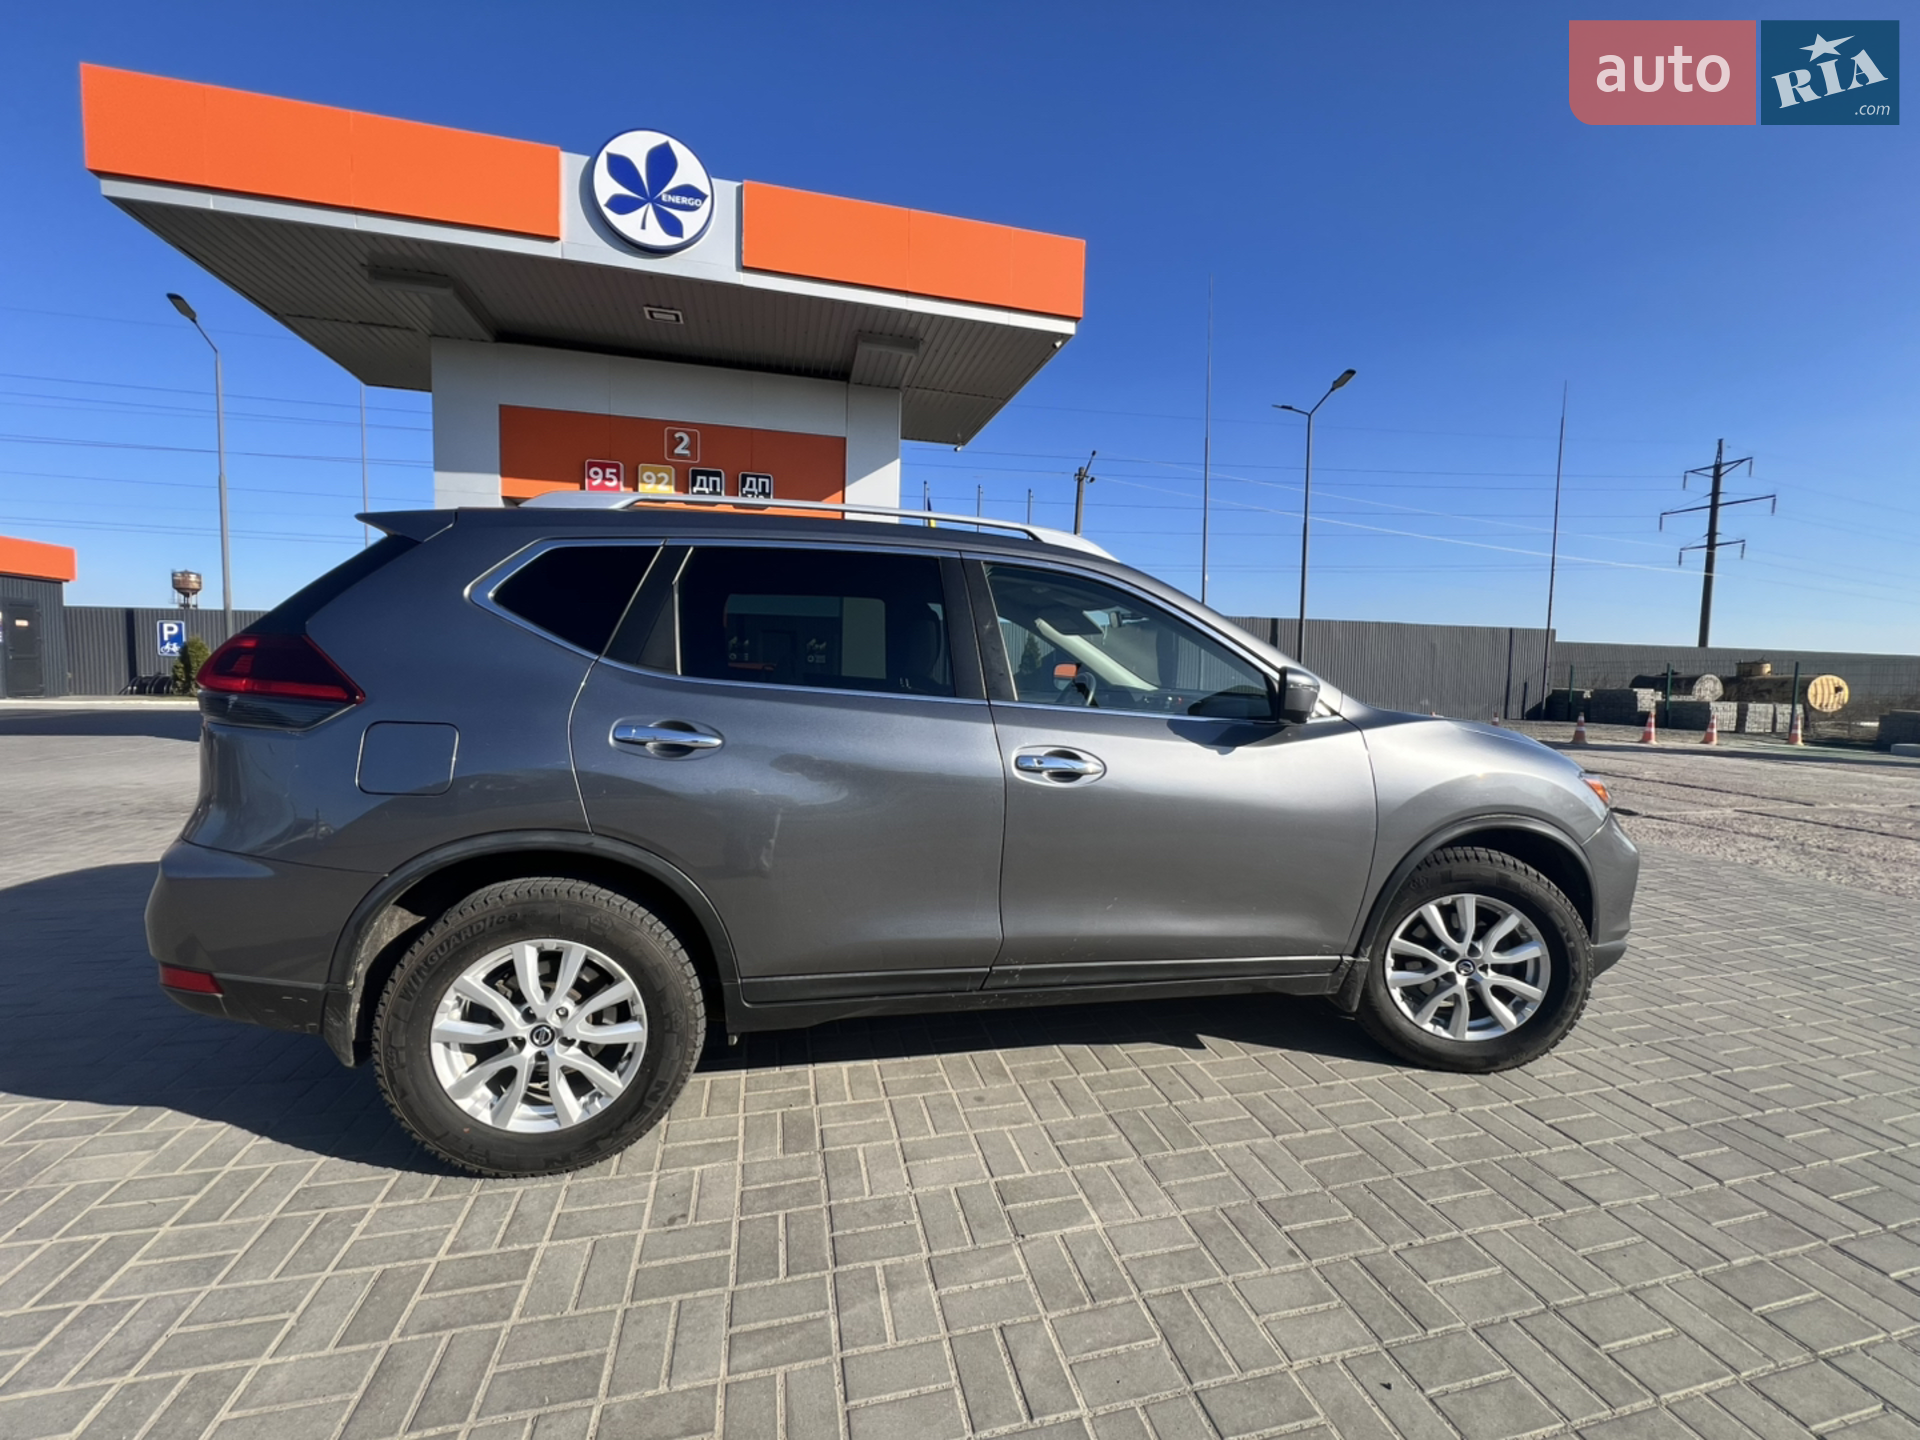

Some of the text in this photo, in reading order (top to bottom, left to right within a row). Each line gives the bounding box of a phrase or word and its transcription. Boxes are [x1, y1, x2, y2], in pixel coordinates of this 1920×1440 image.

[661, 193, 703, 207] ENERGO
[673, 431, 692, 458] 2
[588, 467, 618, 487] 95
[642, 471, 670, 492] 92
[692, 475, 721, 495] ДП
[742, 476, 770, 496] ДП
[162, 623, 179, 641] P
[399, 919, 486, 1003] WINGUARD
